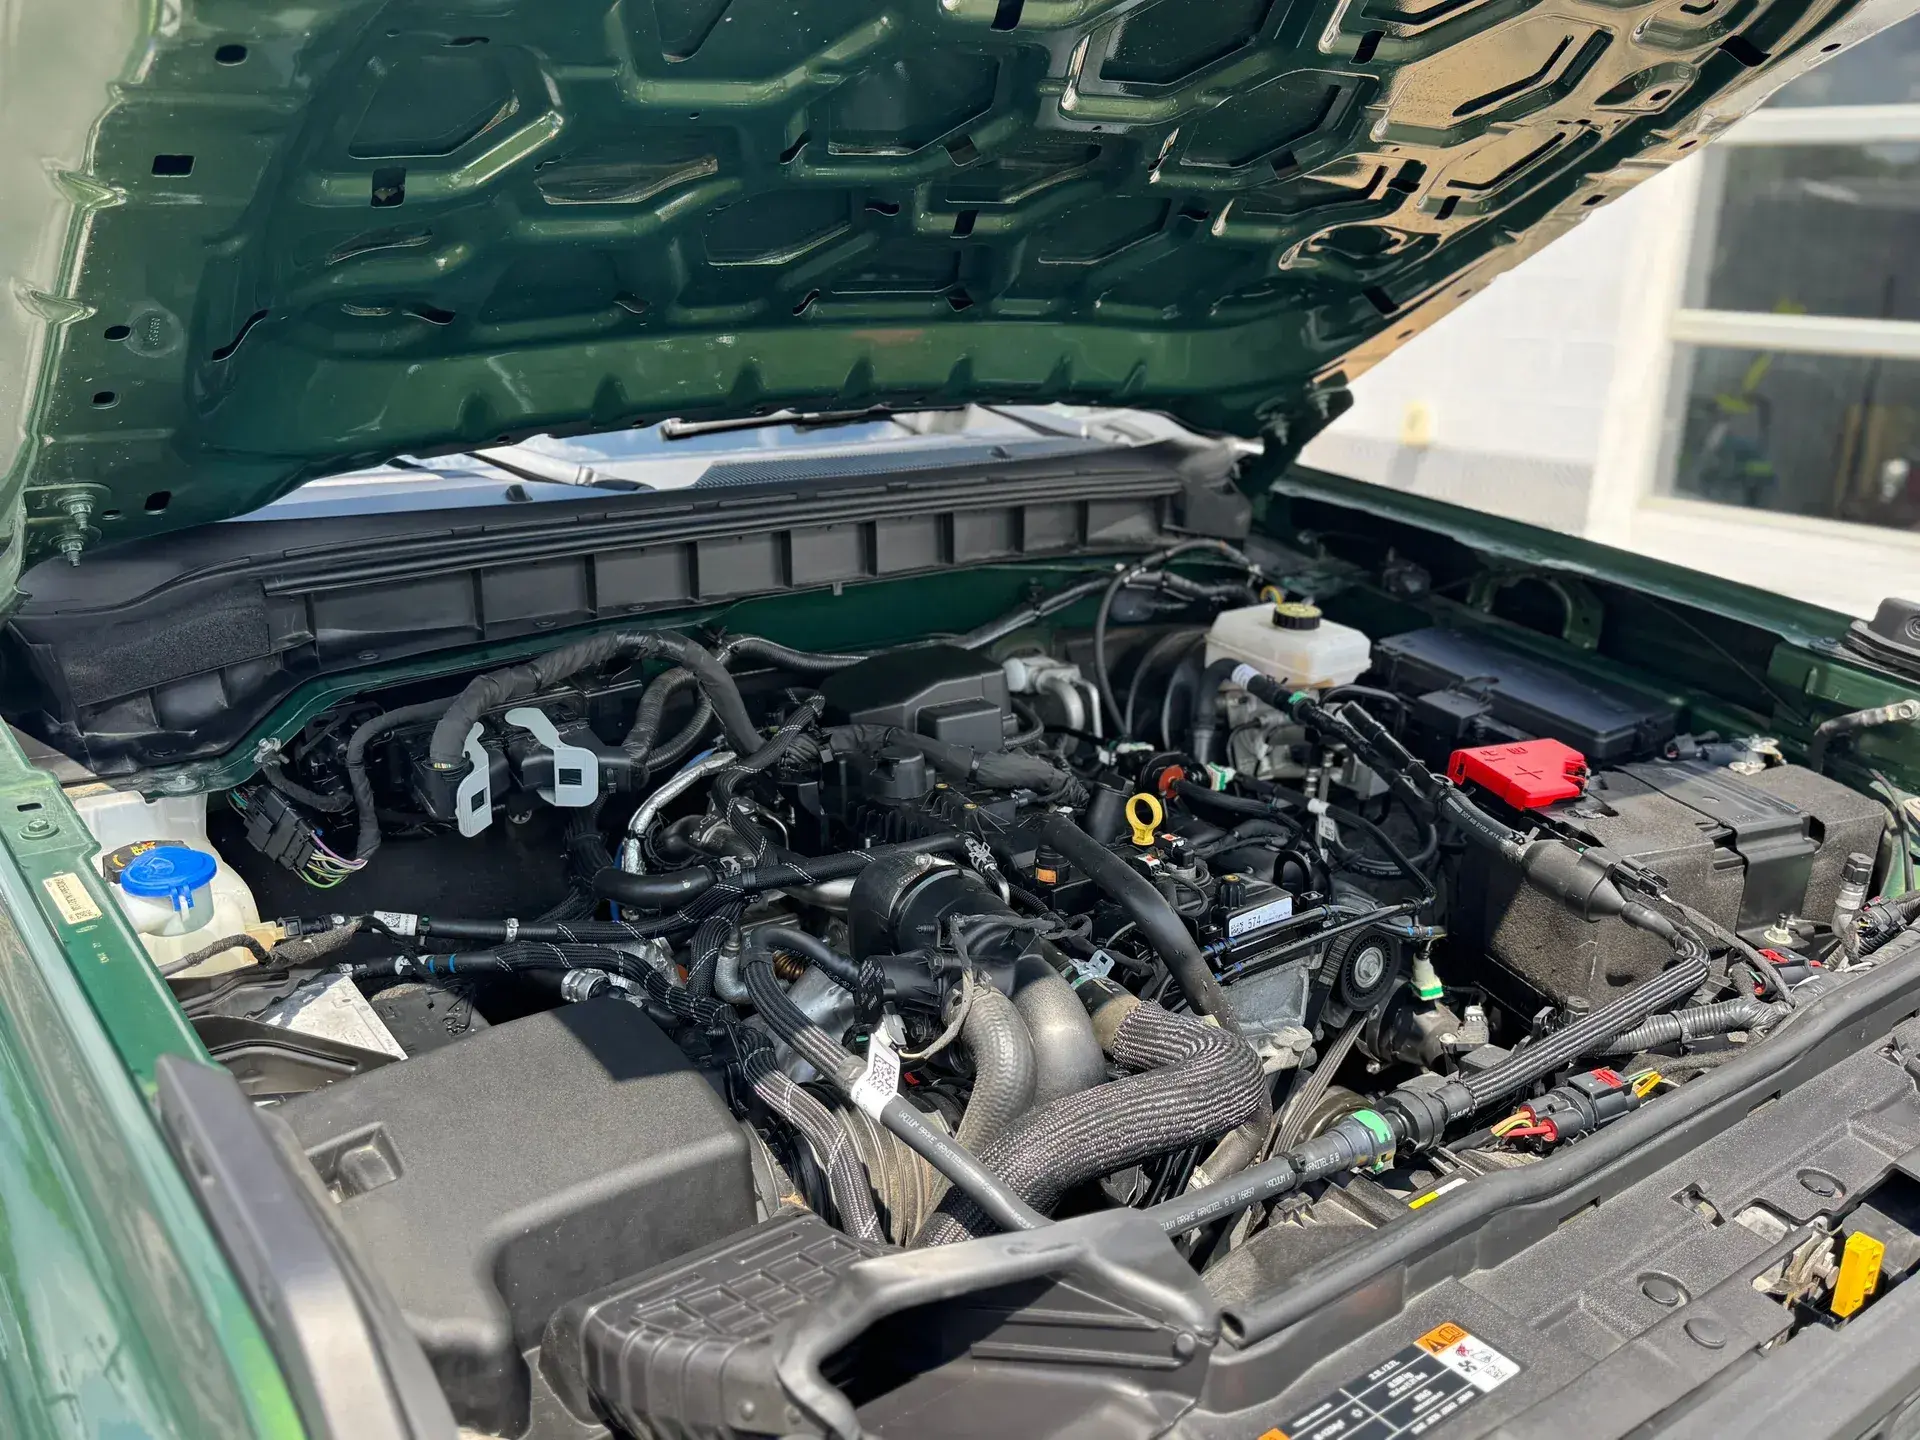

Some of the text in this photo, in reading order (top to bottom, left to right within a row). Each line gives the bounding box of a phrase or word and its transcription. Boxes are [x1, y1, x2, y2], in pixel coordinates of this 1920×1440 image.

[1248, 915, 1261, 928] 574
[918, 1126, 937, 1144] BRAKE
[1177, 1211, 1195, 1226] BRAKE
